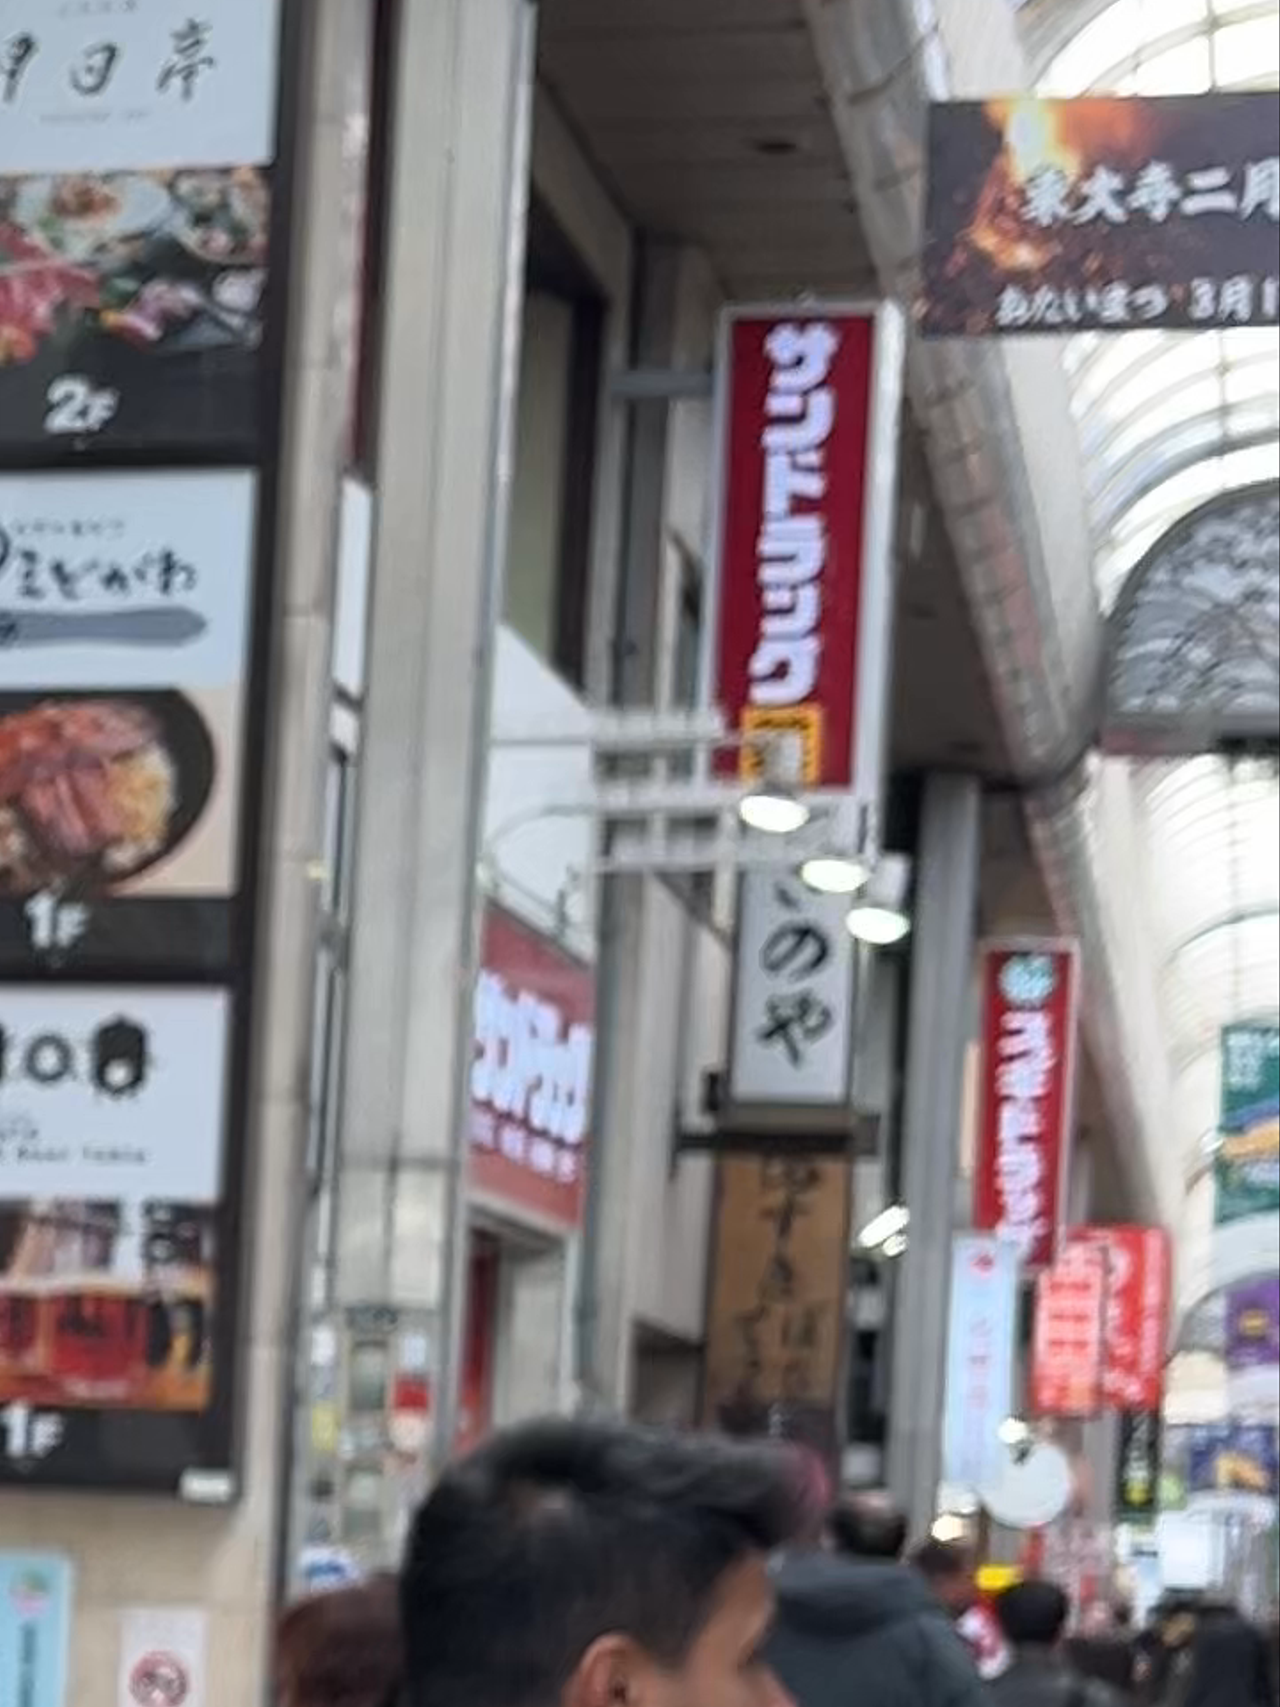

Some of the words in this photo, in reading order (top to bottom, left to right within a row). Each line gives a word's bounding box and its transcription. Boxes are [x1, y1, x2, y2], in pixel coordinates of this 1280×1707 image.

[44, 373, 120, 435] 2F
[747, 321, 840, 708] サンドラッグ
[24, 892, 88, 949] 1F
